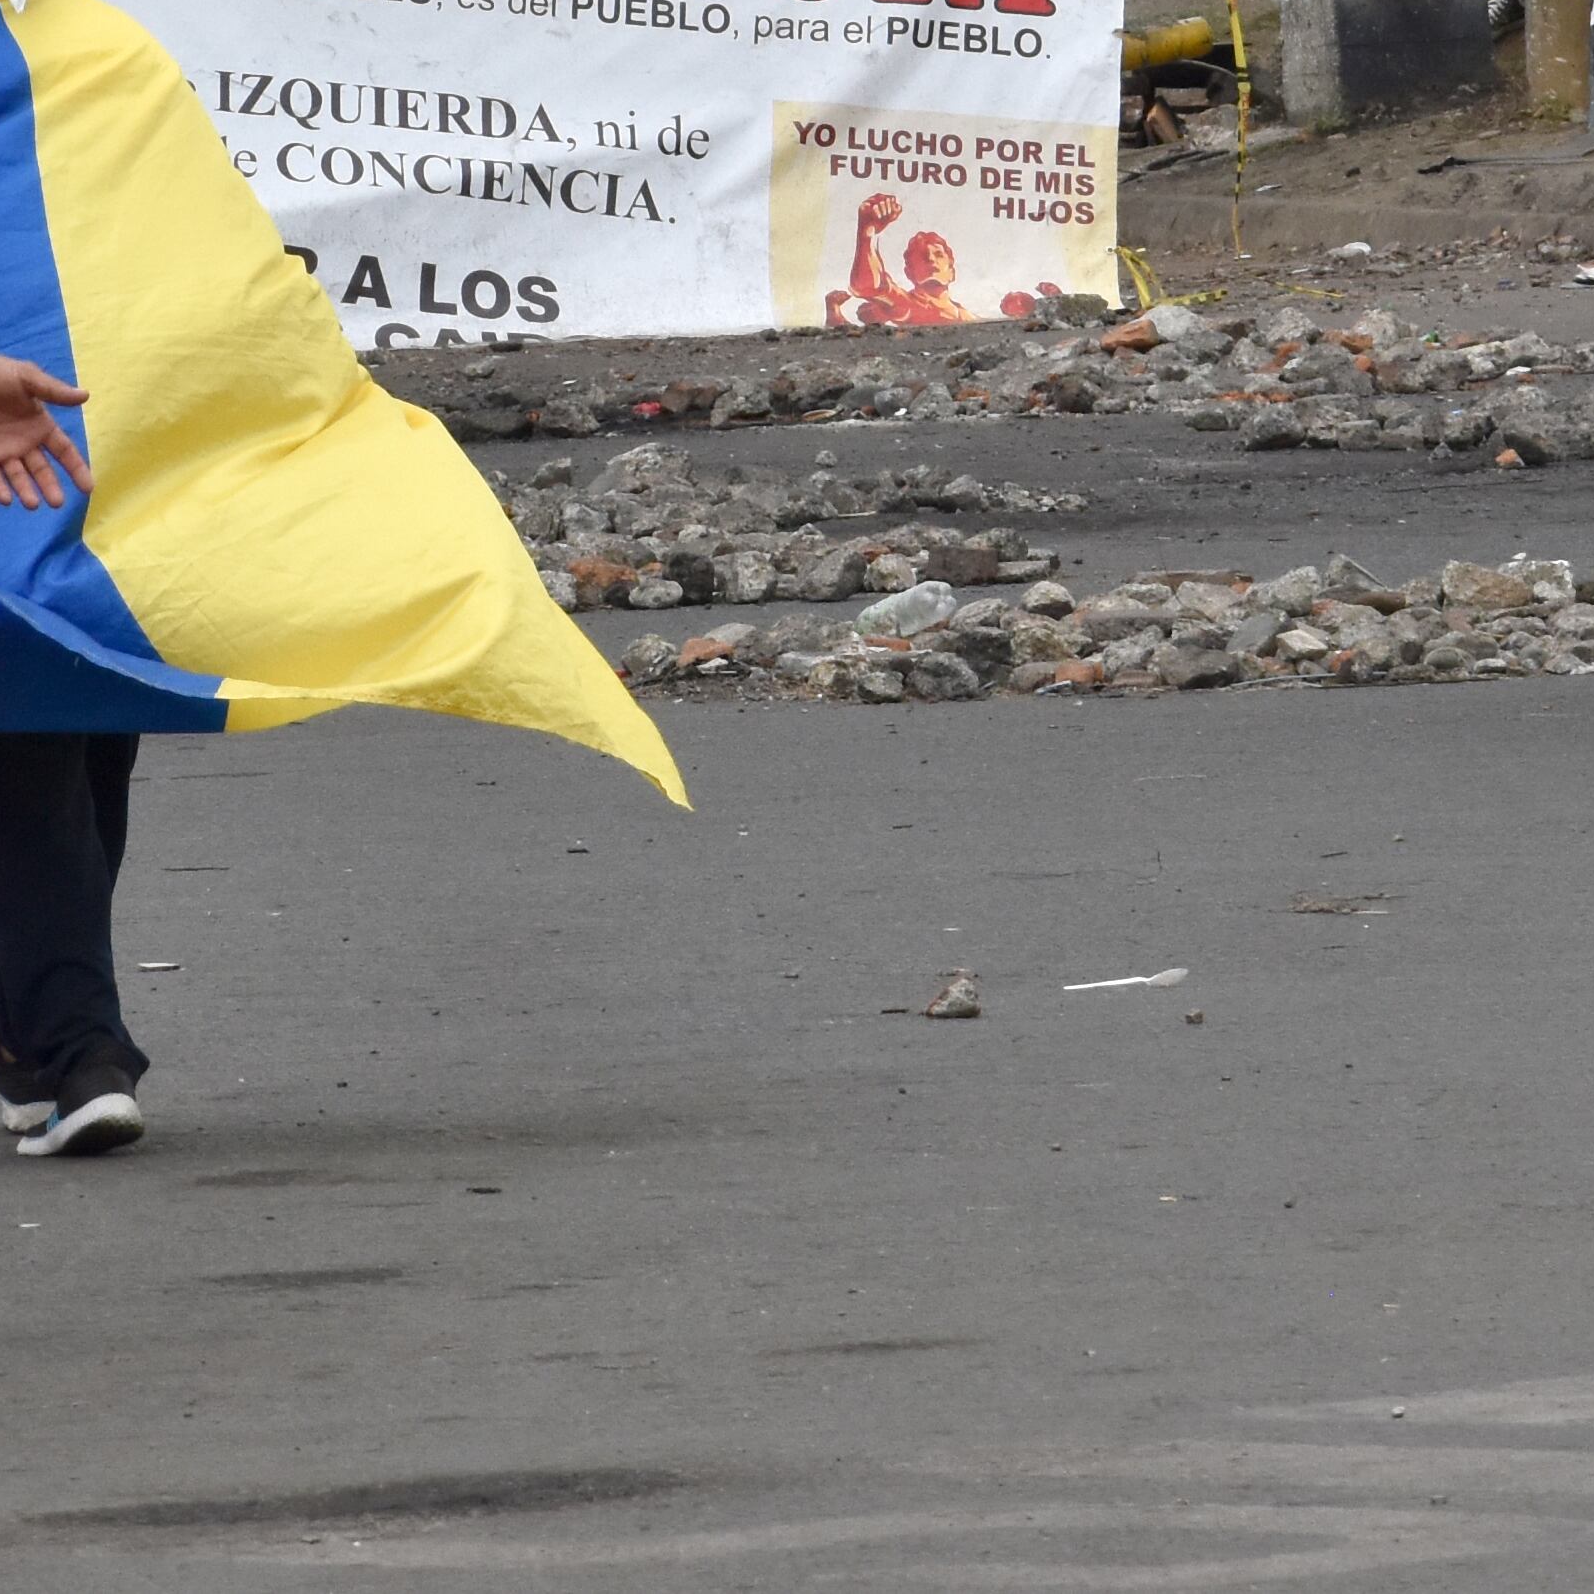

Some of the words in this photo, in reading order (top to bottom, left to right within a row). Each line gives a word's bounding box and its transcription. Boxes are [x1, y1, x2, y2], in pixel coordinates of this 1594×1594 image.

[753, 14, 830, 45] para
[843, 13, 873, 44] el
[887, 16, 1053, 60] PUEBLO.
[216, 70, 578, 153] IZQUIERDA,
[594, 110, 639, 152] ni
[657, 115, 711, 160] de
[793, 121, 836, 148] YO
[848, 127, 963, 158] LUCHO
[975, 137, 1043, 165] POR
[1055, 144, 1096, 168] EL
[276, 141, 677, 225] CONCIENCIA.
[830, 154, 968, 187] FUTURO
[980, 166, 1023, 192] DE
[1034, 170, 1096, 196] MIS
[992, 196, 1096, 225] HIJOS
[341, 255, 392, 308] A
[418, 262, 561, 323] LOS
